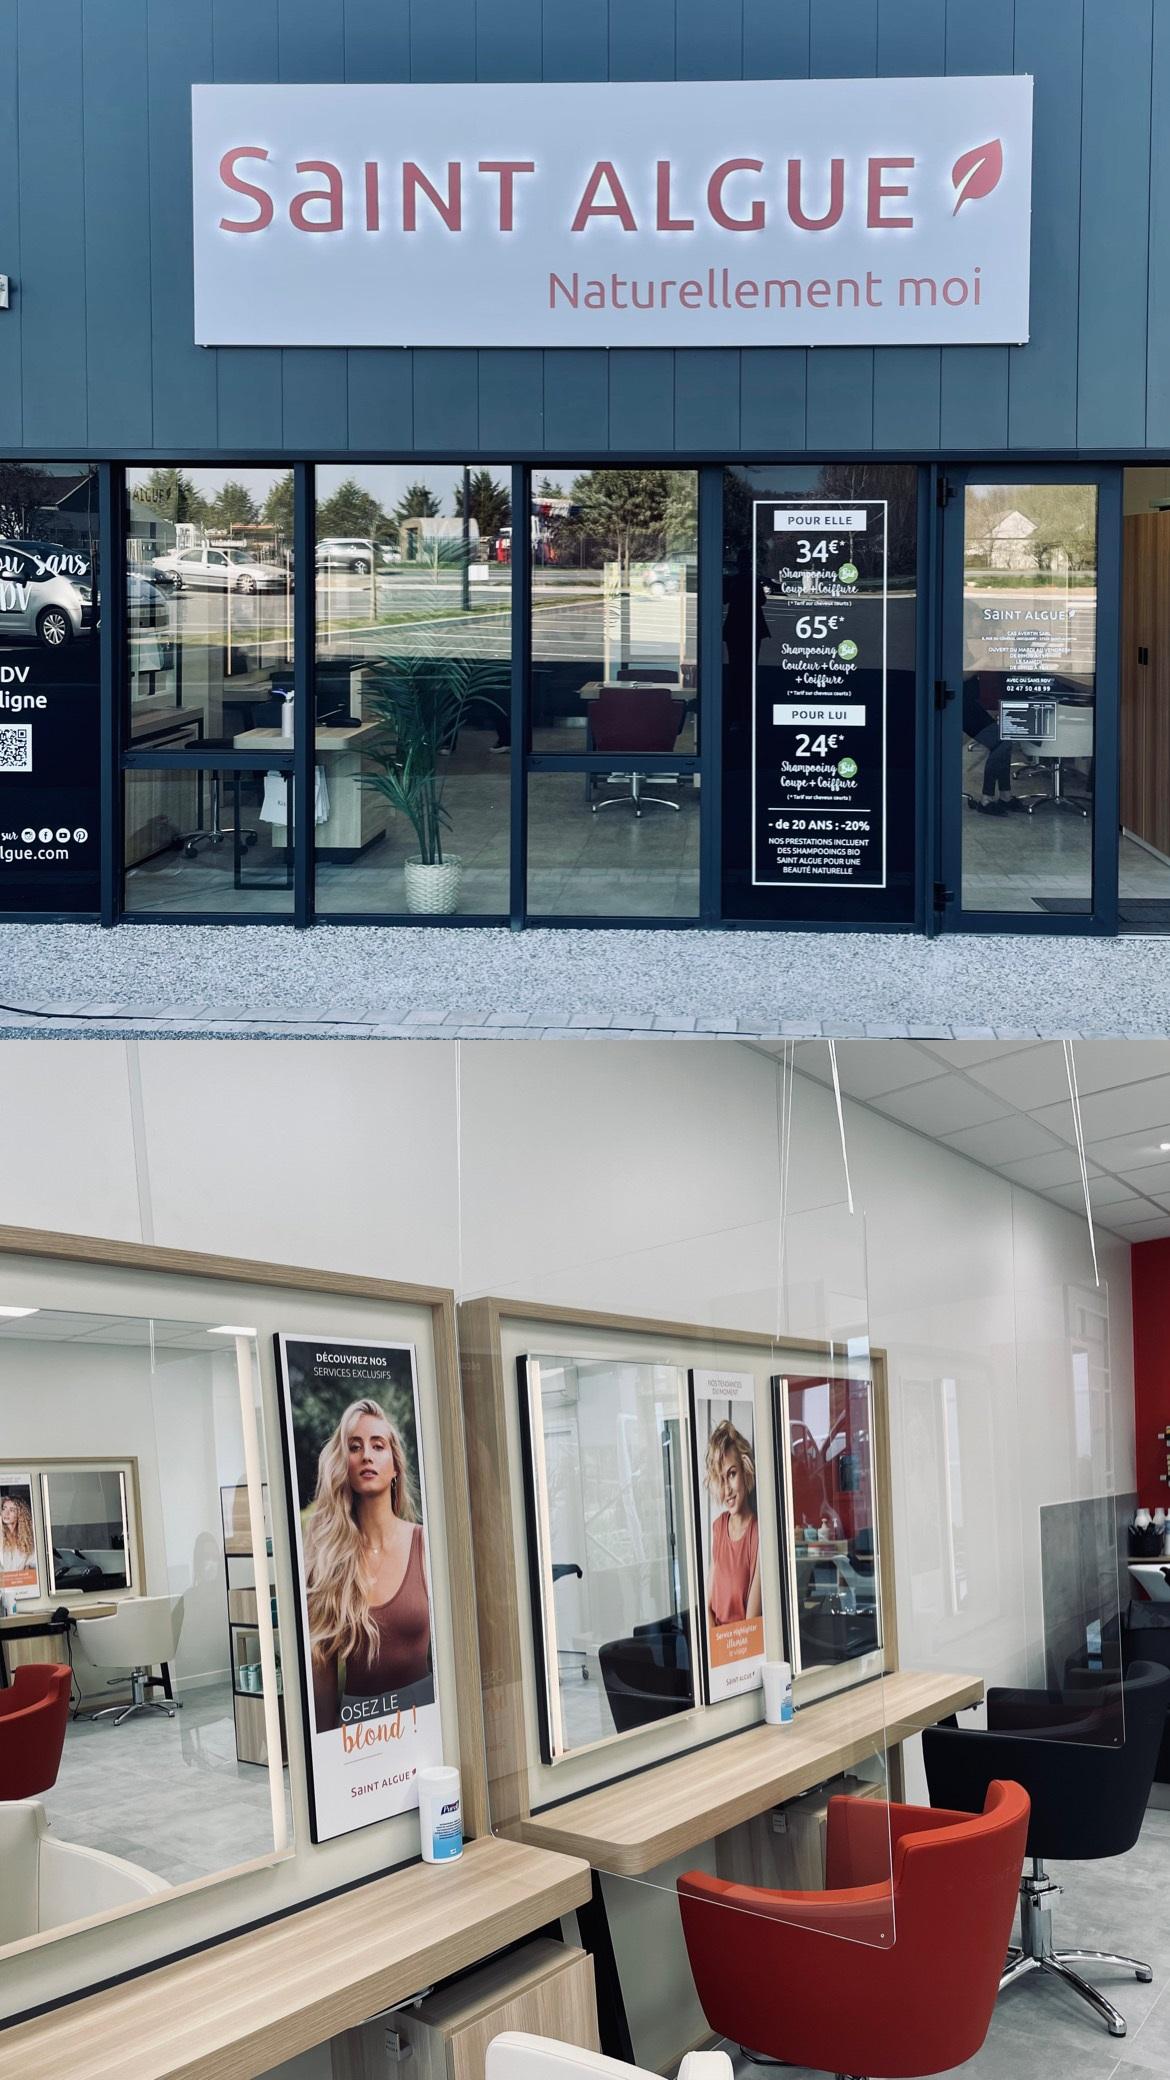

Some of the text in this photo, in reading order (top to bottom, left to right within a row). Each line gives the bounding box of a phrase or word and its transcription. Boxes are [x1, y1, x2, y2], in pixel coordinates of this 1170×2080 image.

[571, 157, 915, 232] ALGUE
[549, 266, 981, 309] Naturellement moi
[788, 516, 853, 525] POUR ELLE
[33, 553, 90, 576] sans
[781, 567, 838, 582] Shampooing
[1025, 610, 1065, 620] ALGUE
[781, 643, 838, 659] Shampooing
[0, 666, 30, 683] DV
[792, 711, 847, 720] POUR LUI
[781, 761, 837, 776] Shampooing
[780, 776, 809, 791] Coupe
[818, 776, 857, 791] Coiffure
[775, 819, 790, 829] de
[792, 820, 806, 829] 20
[808, 820, 833, 830] ANS
[840, 821, 870, 831] -20%
[1, 831, 18, 841] sur
[0, 845, 69, 862] lgue.com
[777, 847, 791, 855] DES
[792, 847, 846, 856] SHAMPOOINGS
[799, 857, 823, 865] ALGUE
[823, 857, 844, 865] POUR
[783, 866, 853, 875] BEAUTÉ NATURELLE
[315, 1352, 387, 1366] DÉCOUVREZ NOS
[313, 1366, 391, 1380] SERVICES EXCLUSIFS
[341, 1694, 399, 1722] OSEZ LE
[340, 1709, 405, 1754] blond
[382, 1771, 410, 1788] ALGUE
